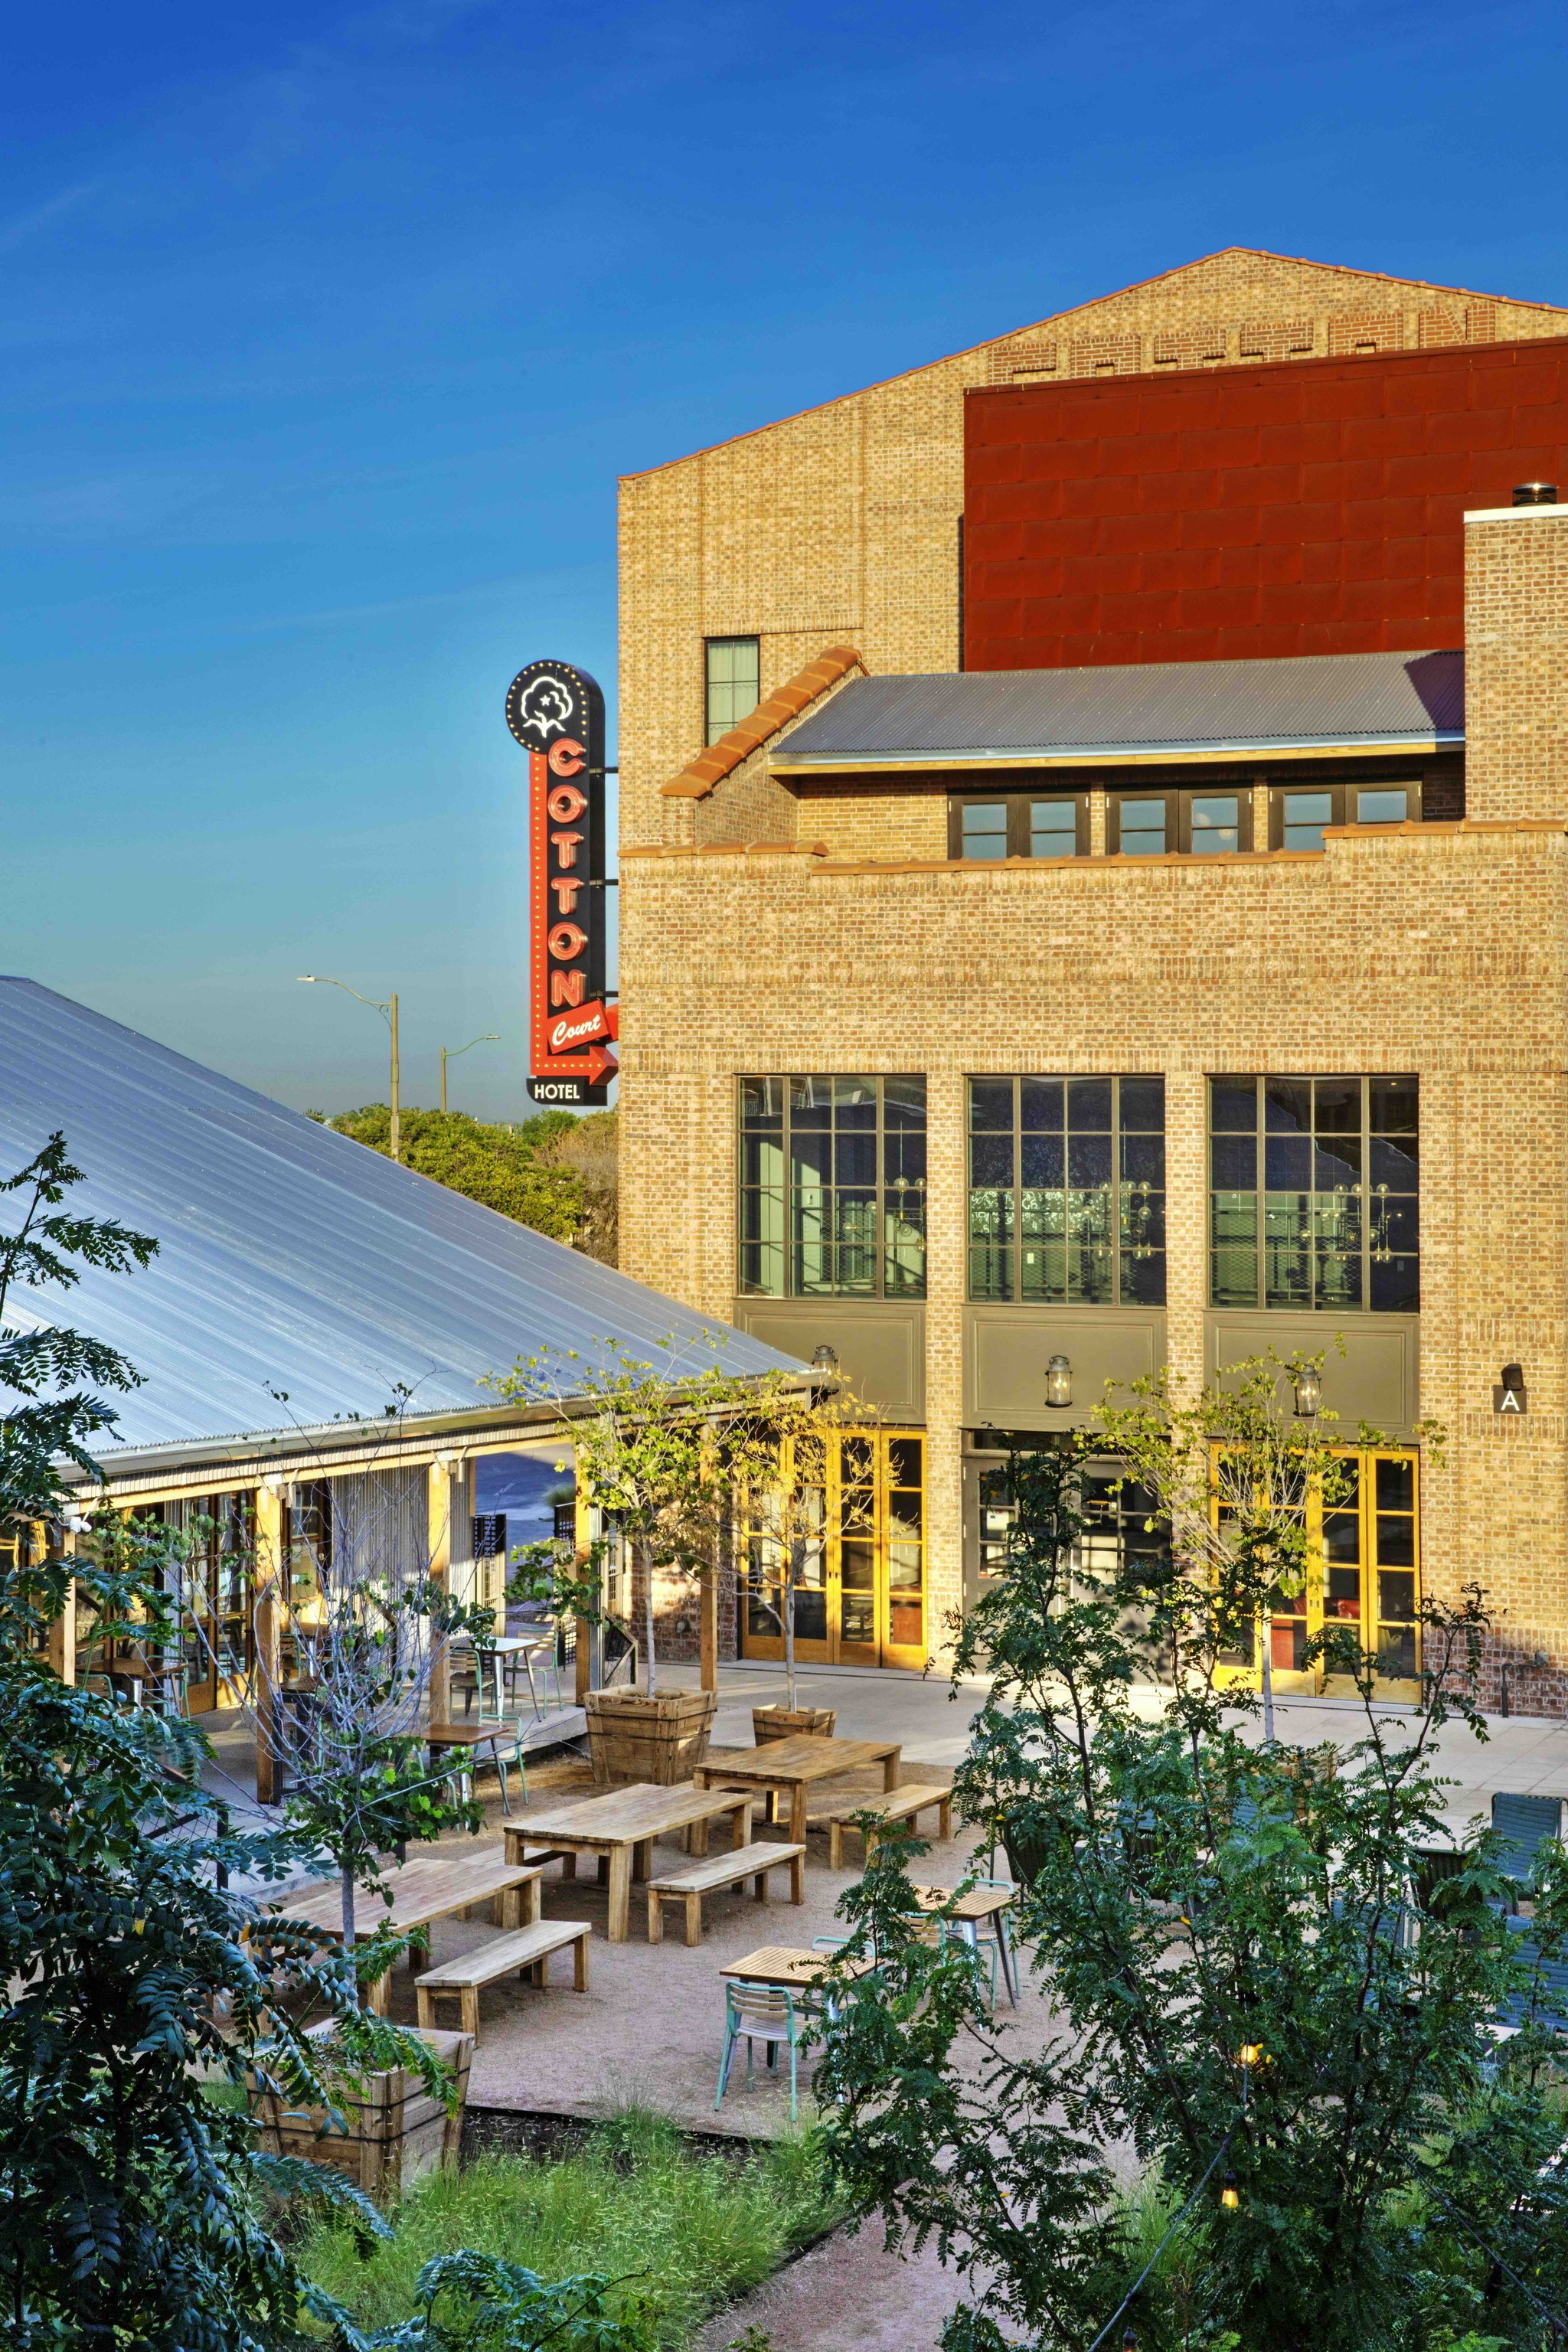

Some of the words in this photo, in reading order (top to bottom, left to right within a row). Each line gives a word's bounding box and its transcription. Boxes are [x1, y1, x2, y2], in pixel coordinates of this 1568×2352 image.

[547, 737, 586, 1008] COTTON
[551, 1014, 601, 1047] Court
[534, 1083, 580, 1099] HOTEL
[1501, 1390, 1520, 1411] A
